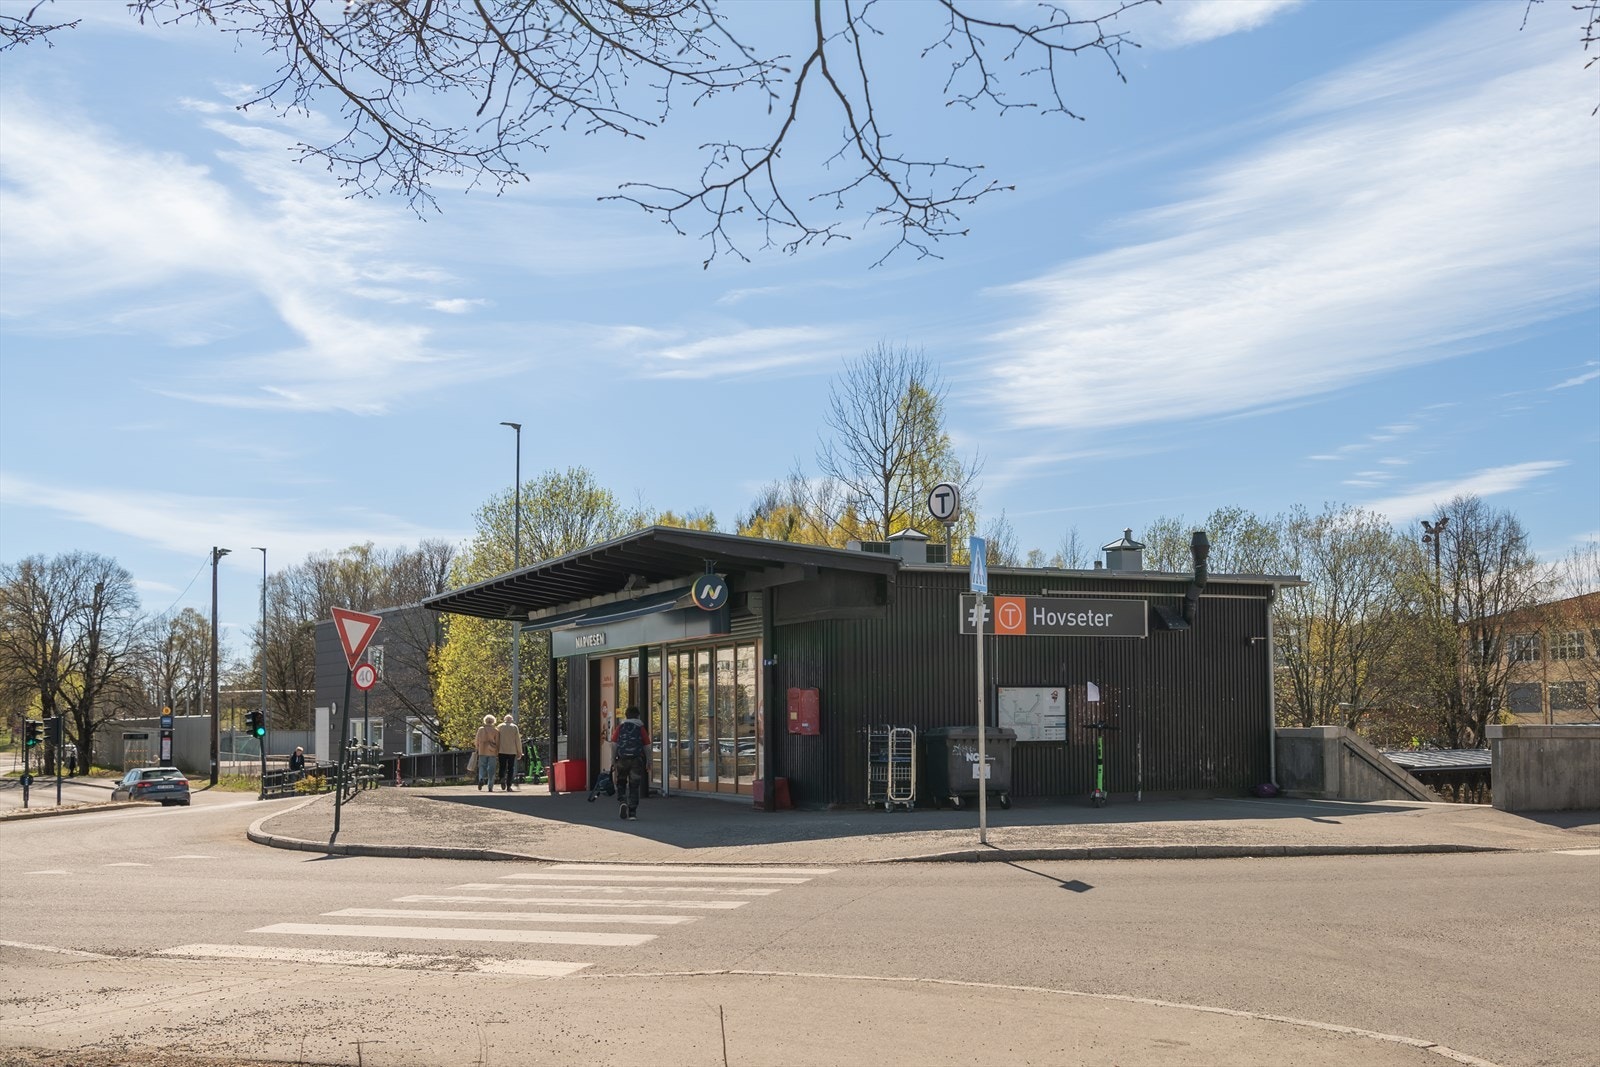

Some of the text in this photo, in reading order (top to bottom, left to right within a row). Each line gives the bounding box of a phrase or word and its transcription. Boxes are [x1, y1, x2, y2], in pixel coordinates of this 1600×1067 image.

[935, 492, 950, 514] T
[1033, 607, 1113, 627] Hovseter
[358, 670, 373, 683] 40
